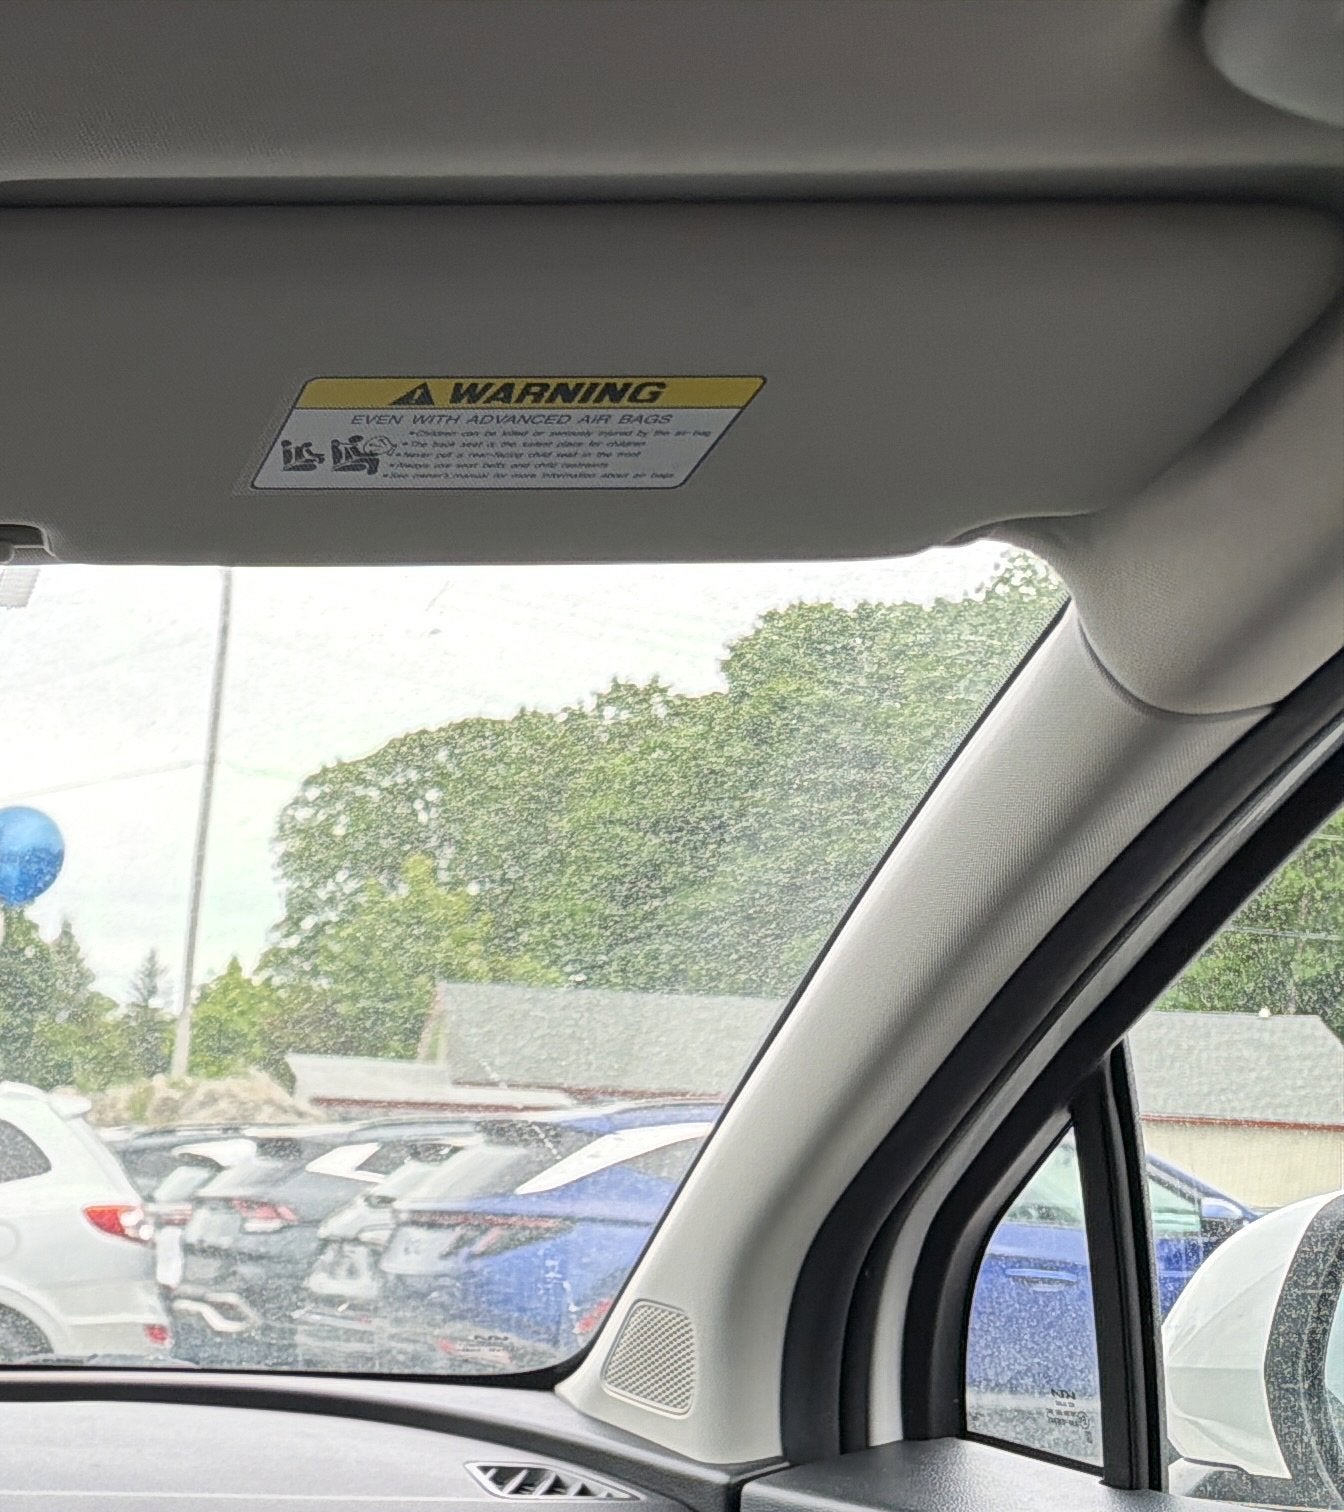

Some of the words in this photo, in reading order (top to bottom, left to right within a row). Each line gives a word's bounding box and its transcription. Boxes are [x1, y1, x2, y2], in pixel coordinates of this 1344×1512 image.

[448, 381, 667, 405] WARNING
[350, 414, 404, 425] EVEN
[412, 414, 461, 425] WITH
[465, 414, 572, 425] ADVANCED
[577, 414, 612, 424] AIR
[618, 414, 673, 424] BAGS
